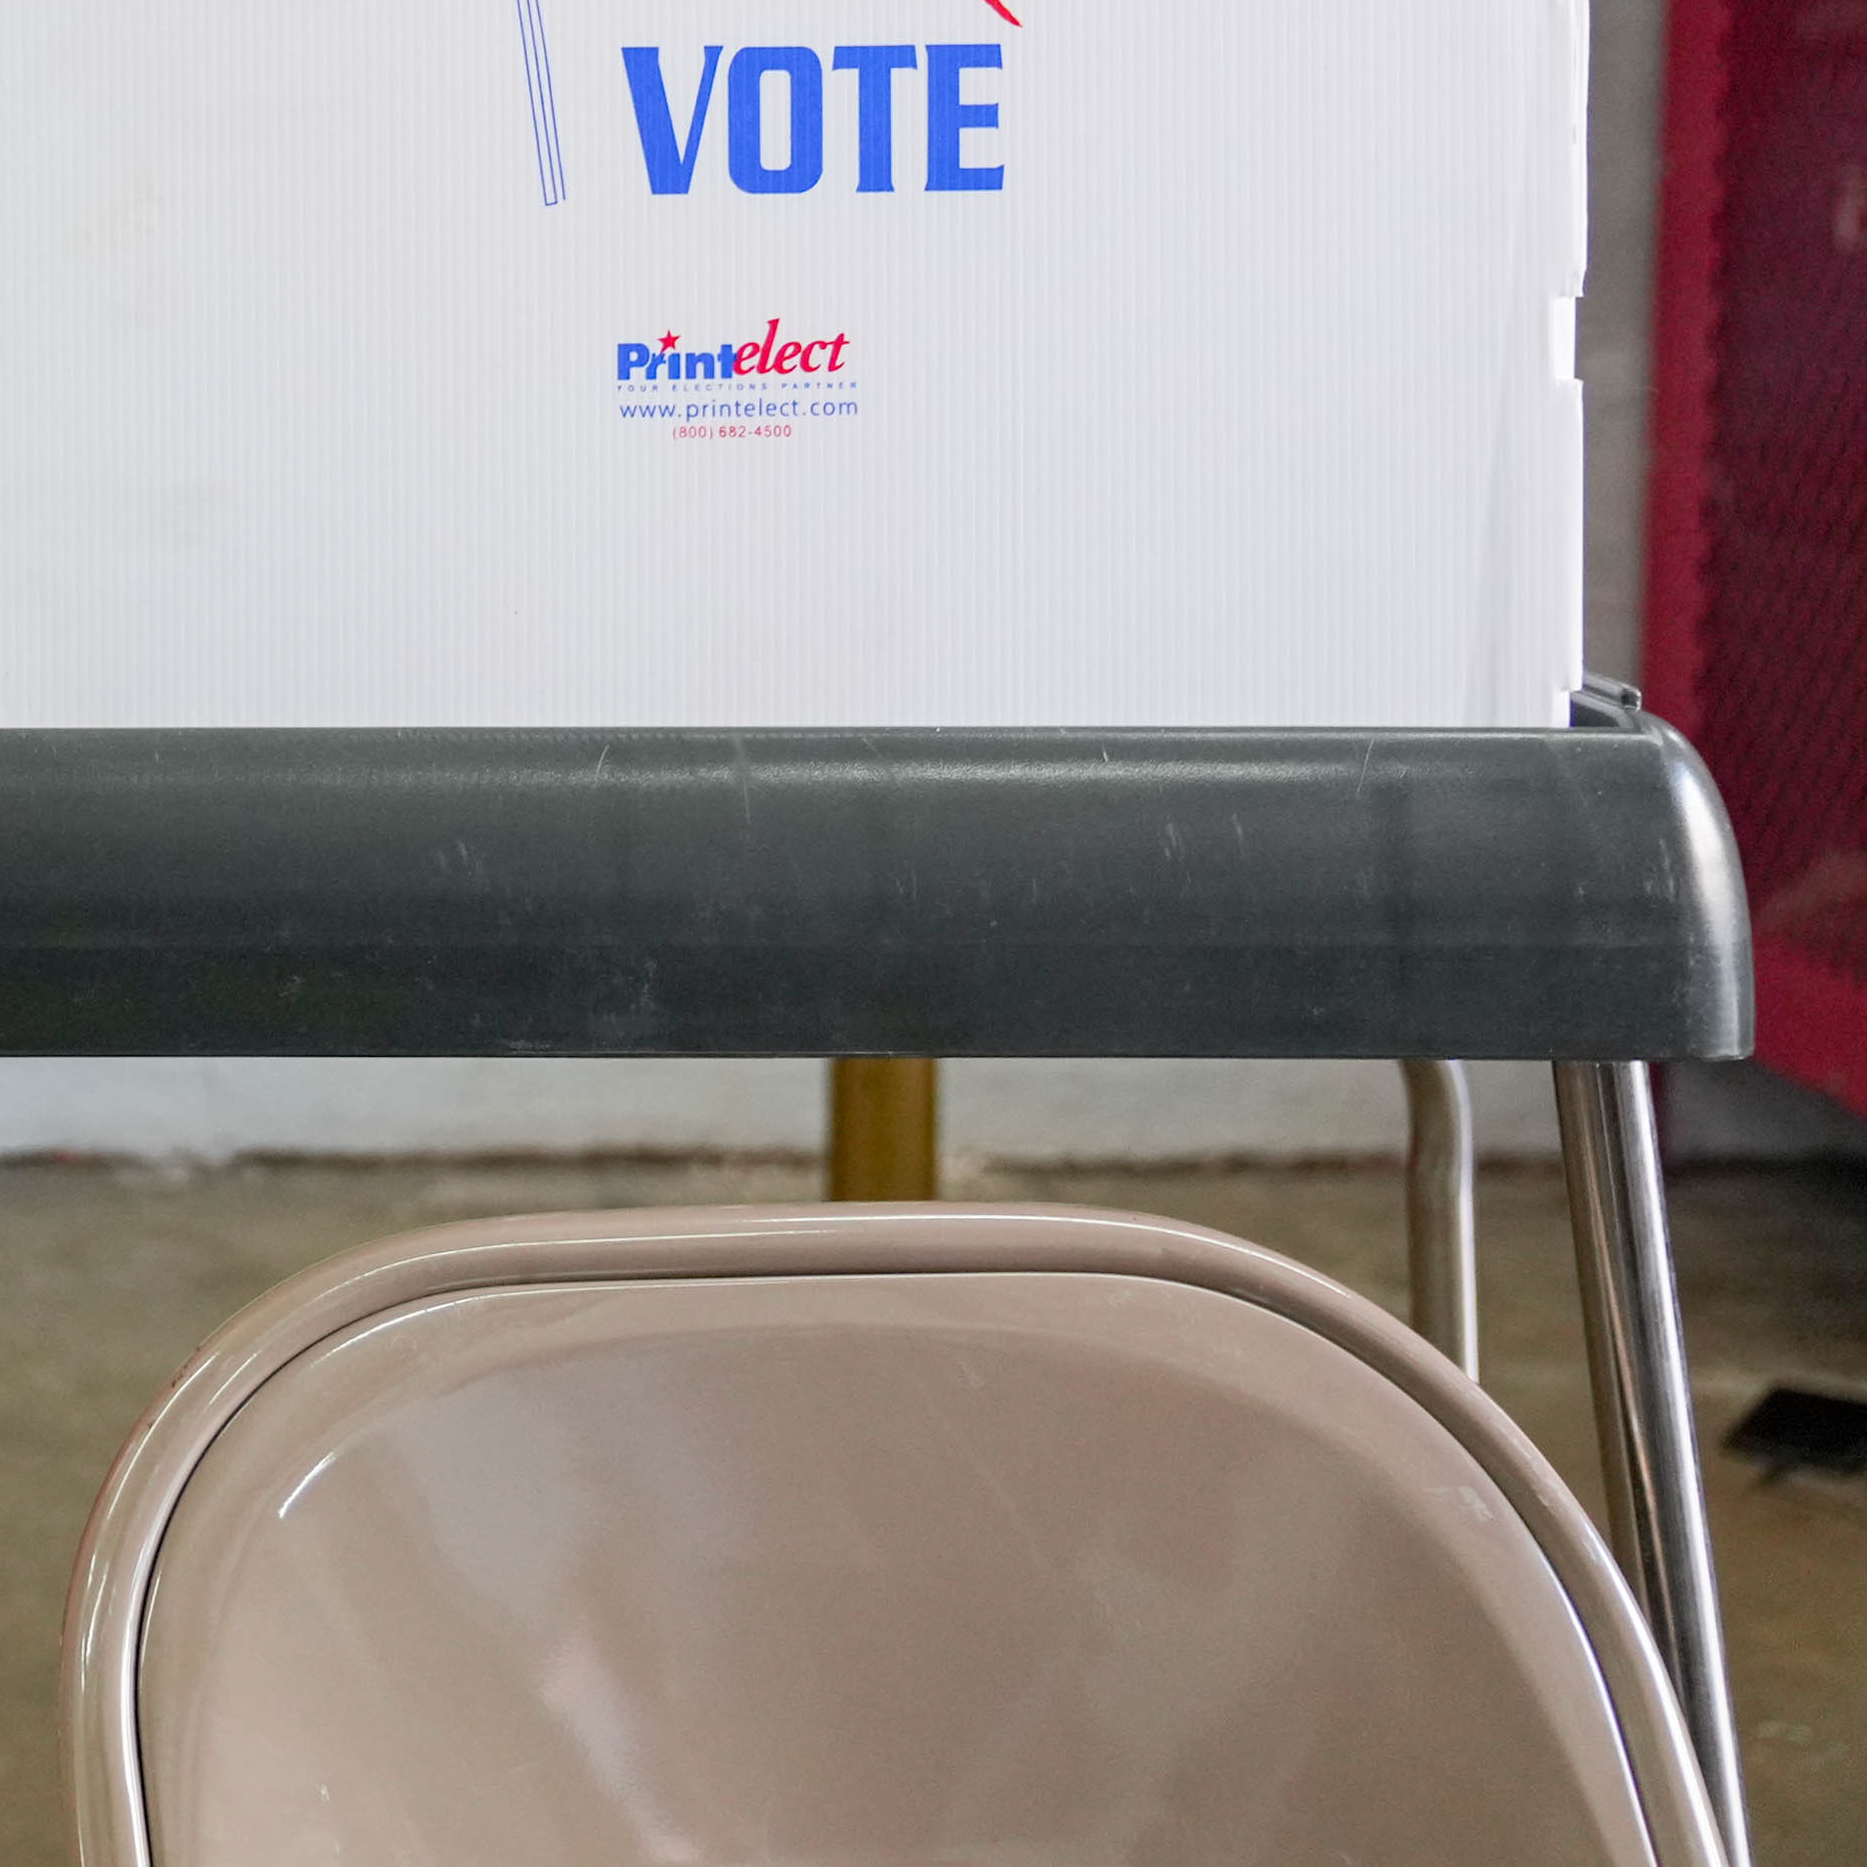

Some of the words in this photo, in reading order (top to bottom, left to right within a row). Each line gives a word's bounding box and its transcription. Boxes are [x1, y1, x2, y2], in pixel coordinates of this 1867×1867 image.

[620, 43, 1006, 195] VOTE
[616, 384, 659, 393] YOUR
[672, 382, 768, 392] ELECTIONS
[781, 381, 857, 390] PARTNER
[619, 398, 858, 422] www.printelect.com
[672, 425, 714, 440] (800)
[718, 424, 792, 438] 682-4500
